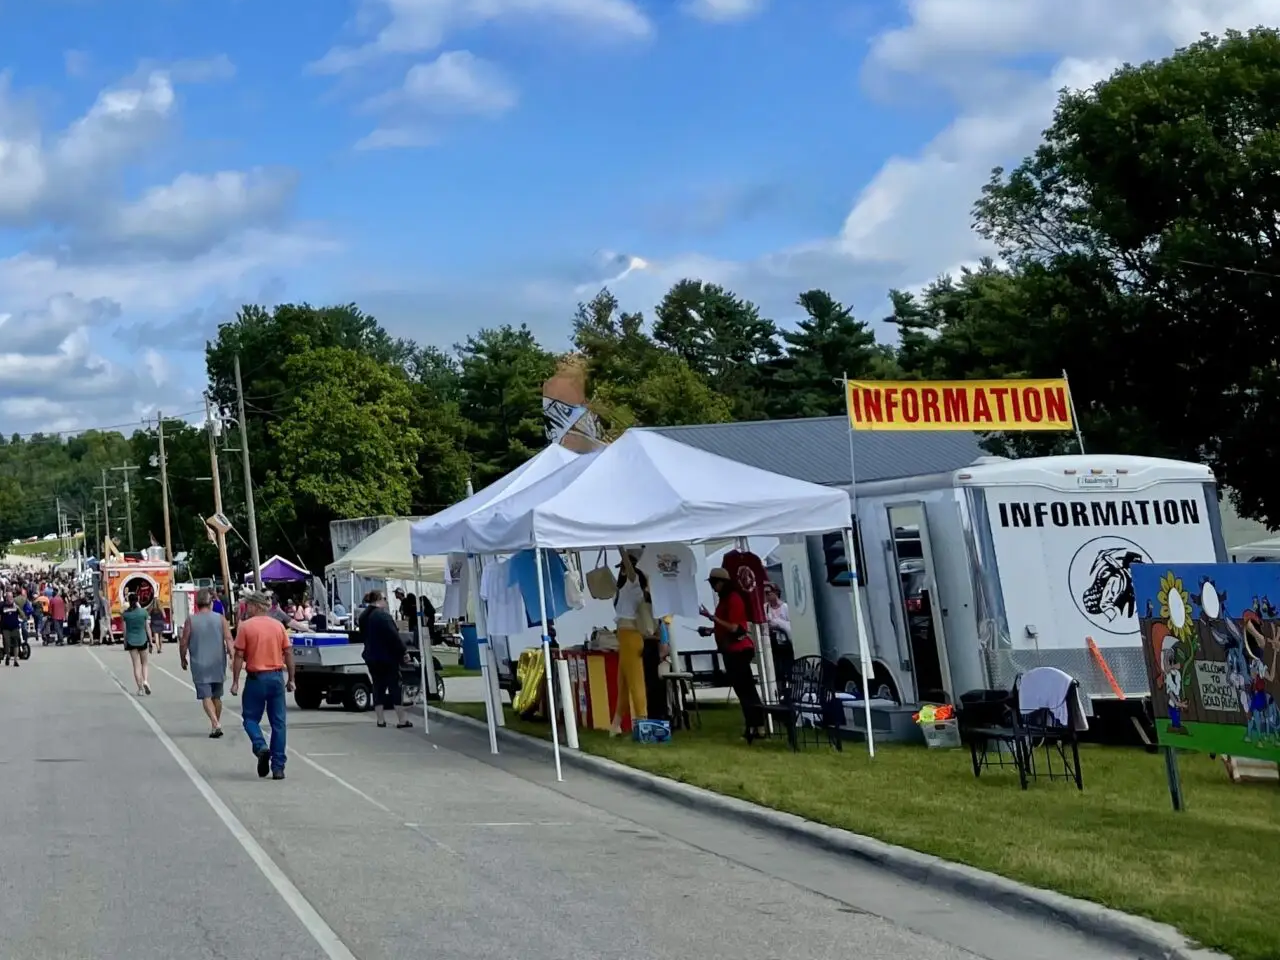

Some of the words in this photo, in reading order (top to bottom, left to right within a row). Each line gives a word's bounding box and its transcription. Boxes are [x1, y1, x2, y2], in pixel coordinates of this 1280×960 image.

[852, 386, 1068, 423] INFORMATION
[998, 499, 1200, 528] INFORMATION
[1198, 662, 1227, 674] WELCOME
[1210, 674, 1221, 684] TO
[1202, 694, 1221, 707] GOLD
[1221, 696, 1238, 709] RUSH
